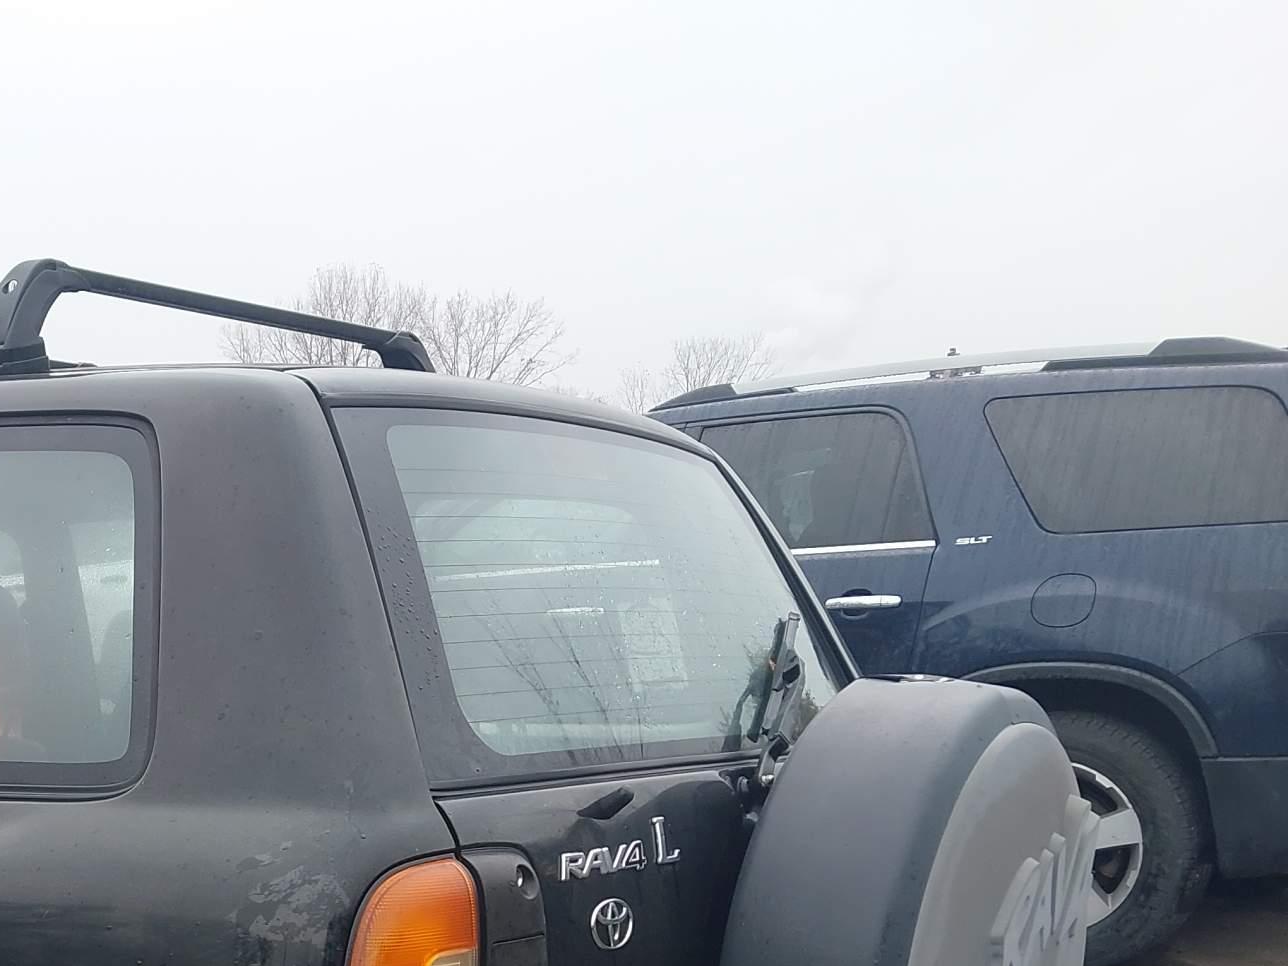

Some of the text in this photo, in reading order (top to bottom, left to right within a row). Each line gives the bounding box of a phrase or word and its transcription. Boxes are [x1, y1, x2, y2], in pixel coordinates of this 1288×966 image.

[955, 536, 993, 545] SLT
[559, 815, 681, 881] RAV4 L
